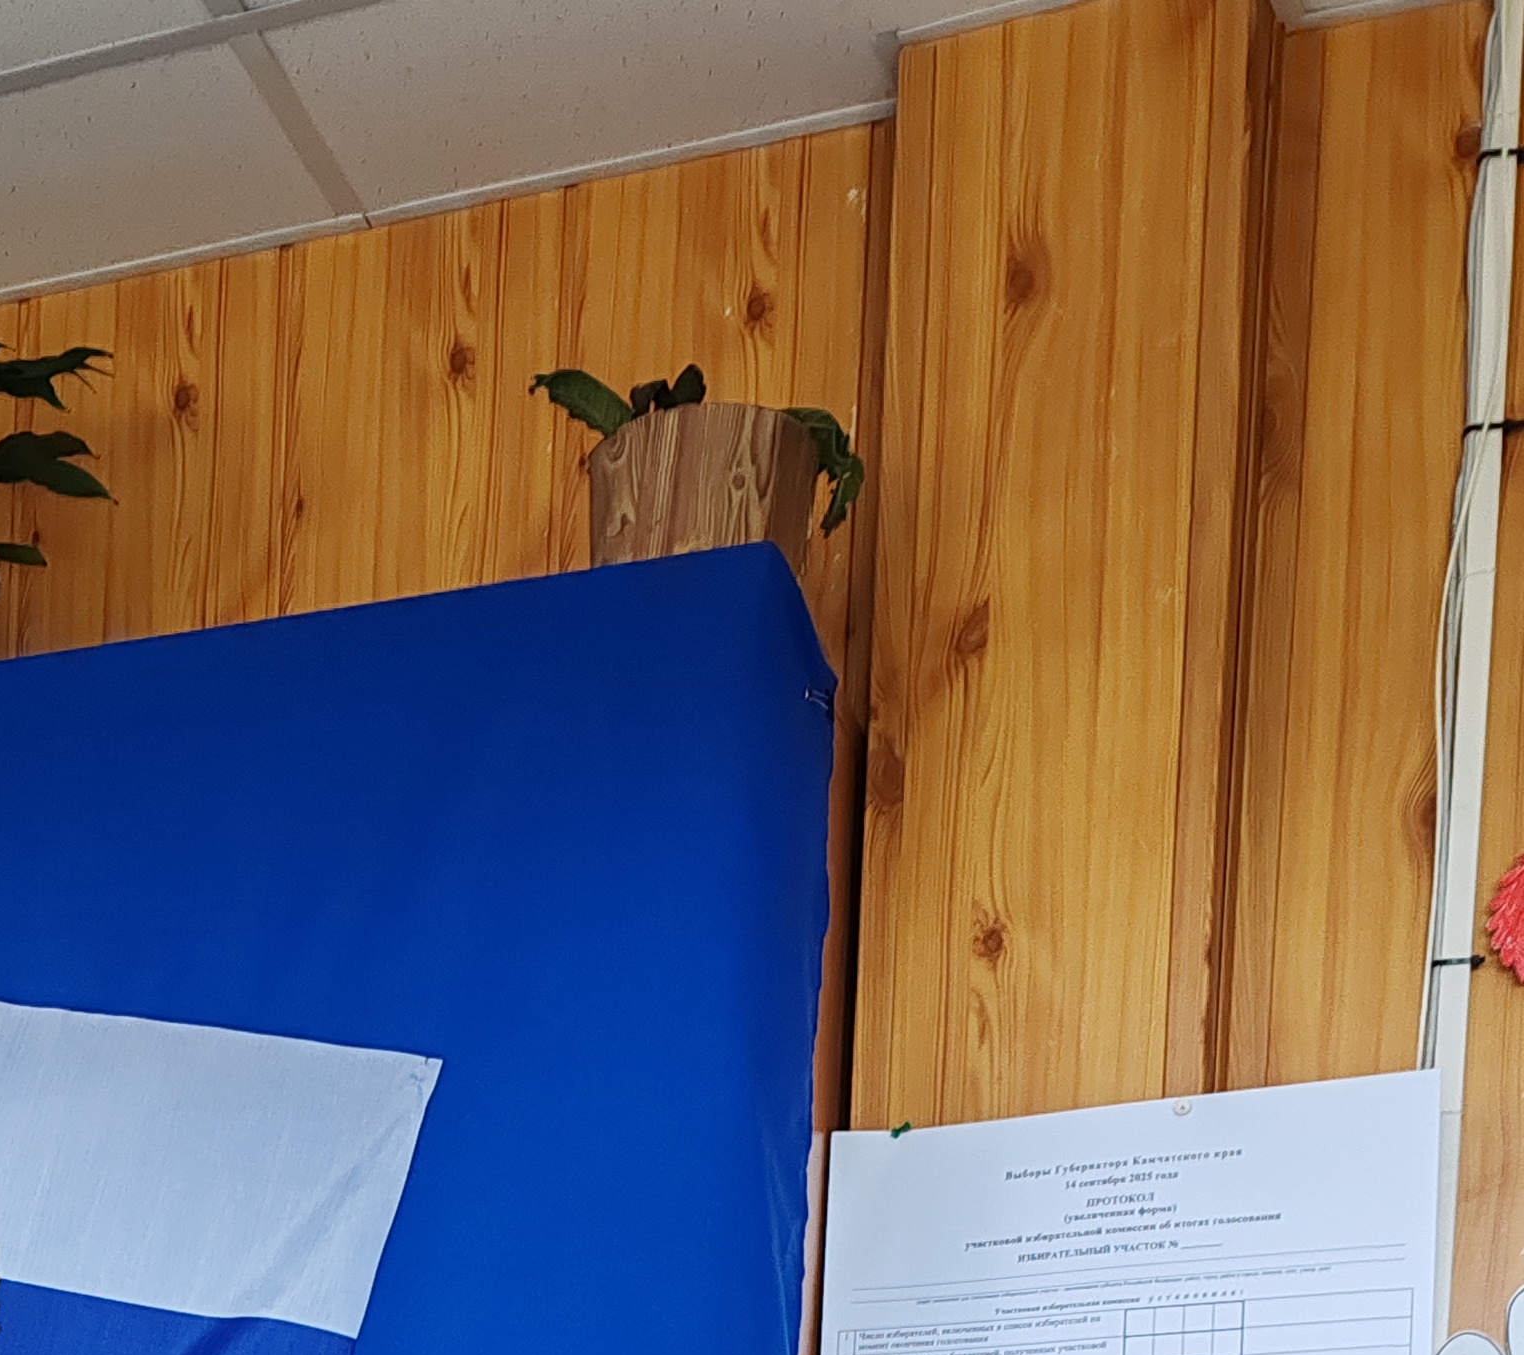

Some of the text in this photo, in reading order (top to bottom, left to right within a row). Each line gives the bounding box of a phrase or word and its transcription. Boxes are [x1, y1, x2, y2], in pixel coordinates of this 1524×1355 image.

[1005, 1149, 1243, 1181] Выборы Губернатора Камчатского края
[1065, 1171, 1179, 1190] 14 сентября 2025 года
[1086, 1192, 1155, 1208] ПРОТОКОЛ
[1064, 1204, 1177, 1224] (увеличенная форма)
[964, 1213, 1281, 1251] участковой избирательной комиссии об итогах голосования
[1017, 1239, 1178, 1263] ИЗБИРАТЕЛЬНЫЙ УЧАСТОК №
